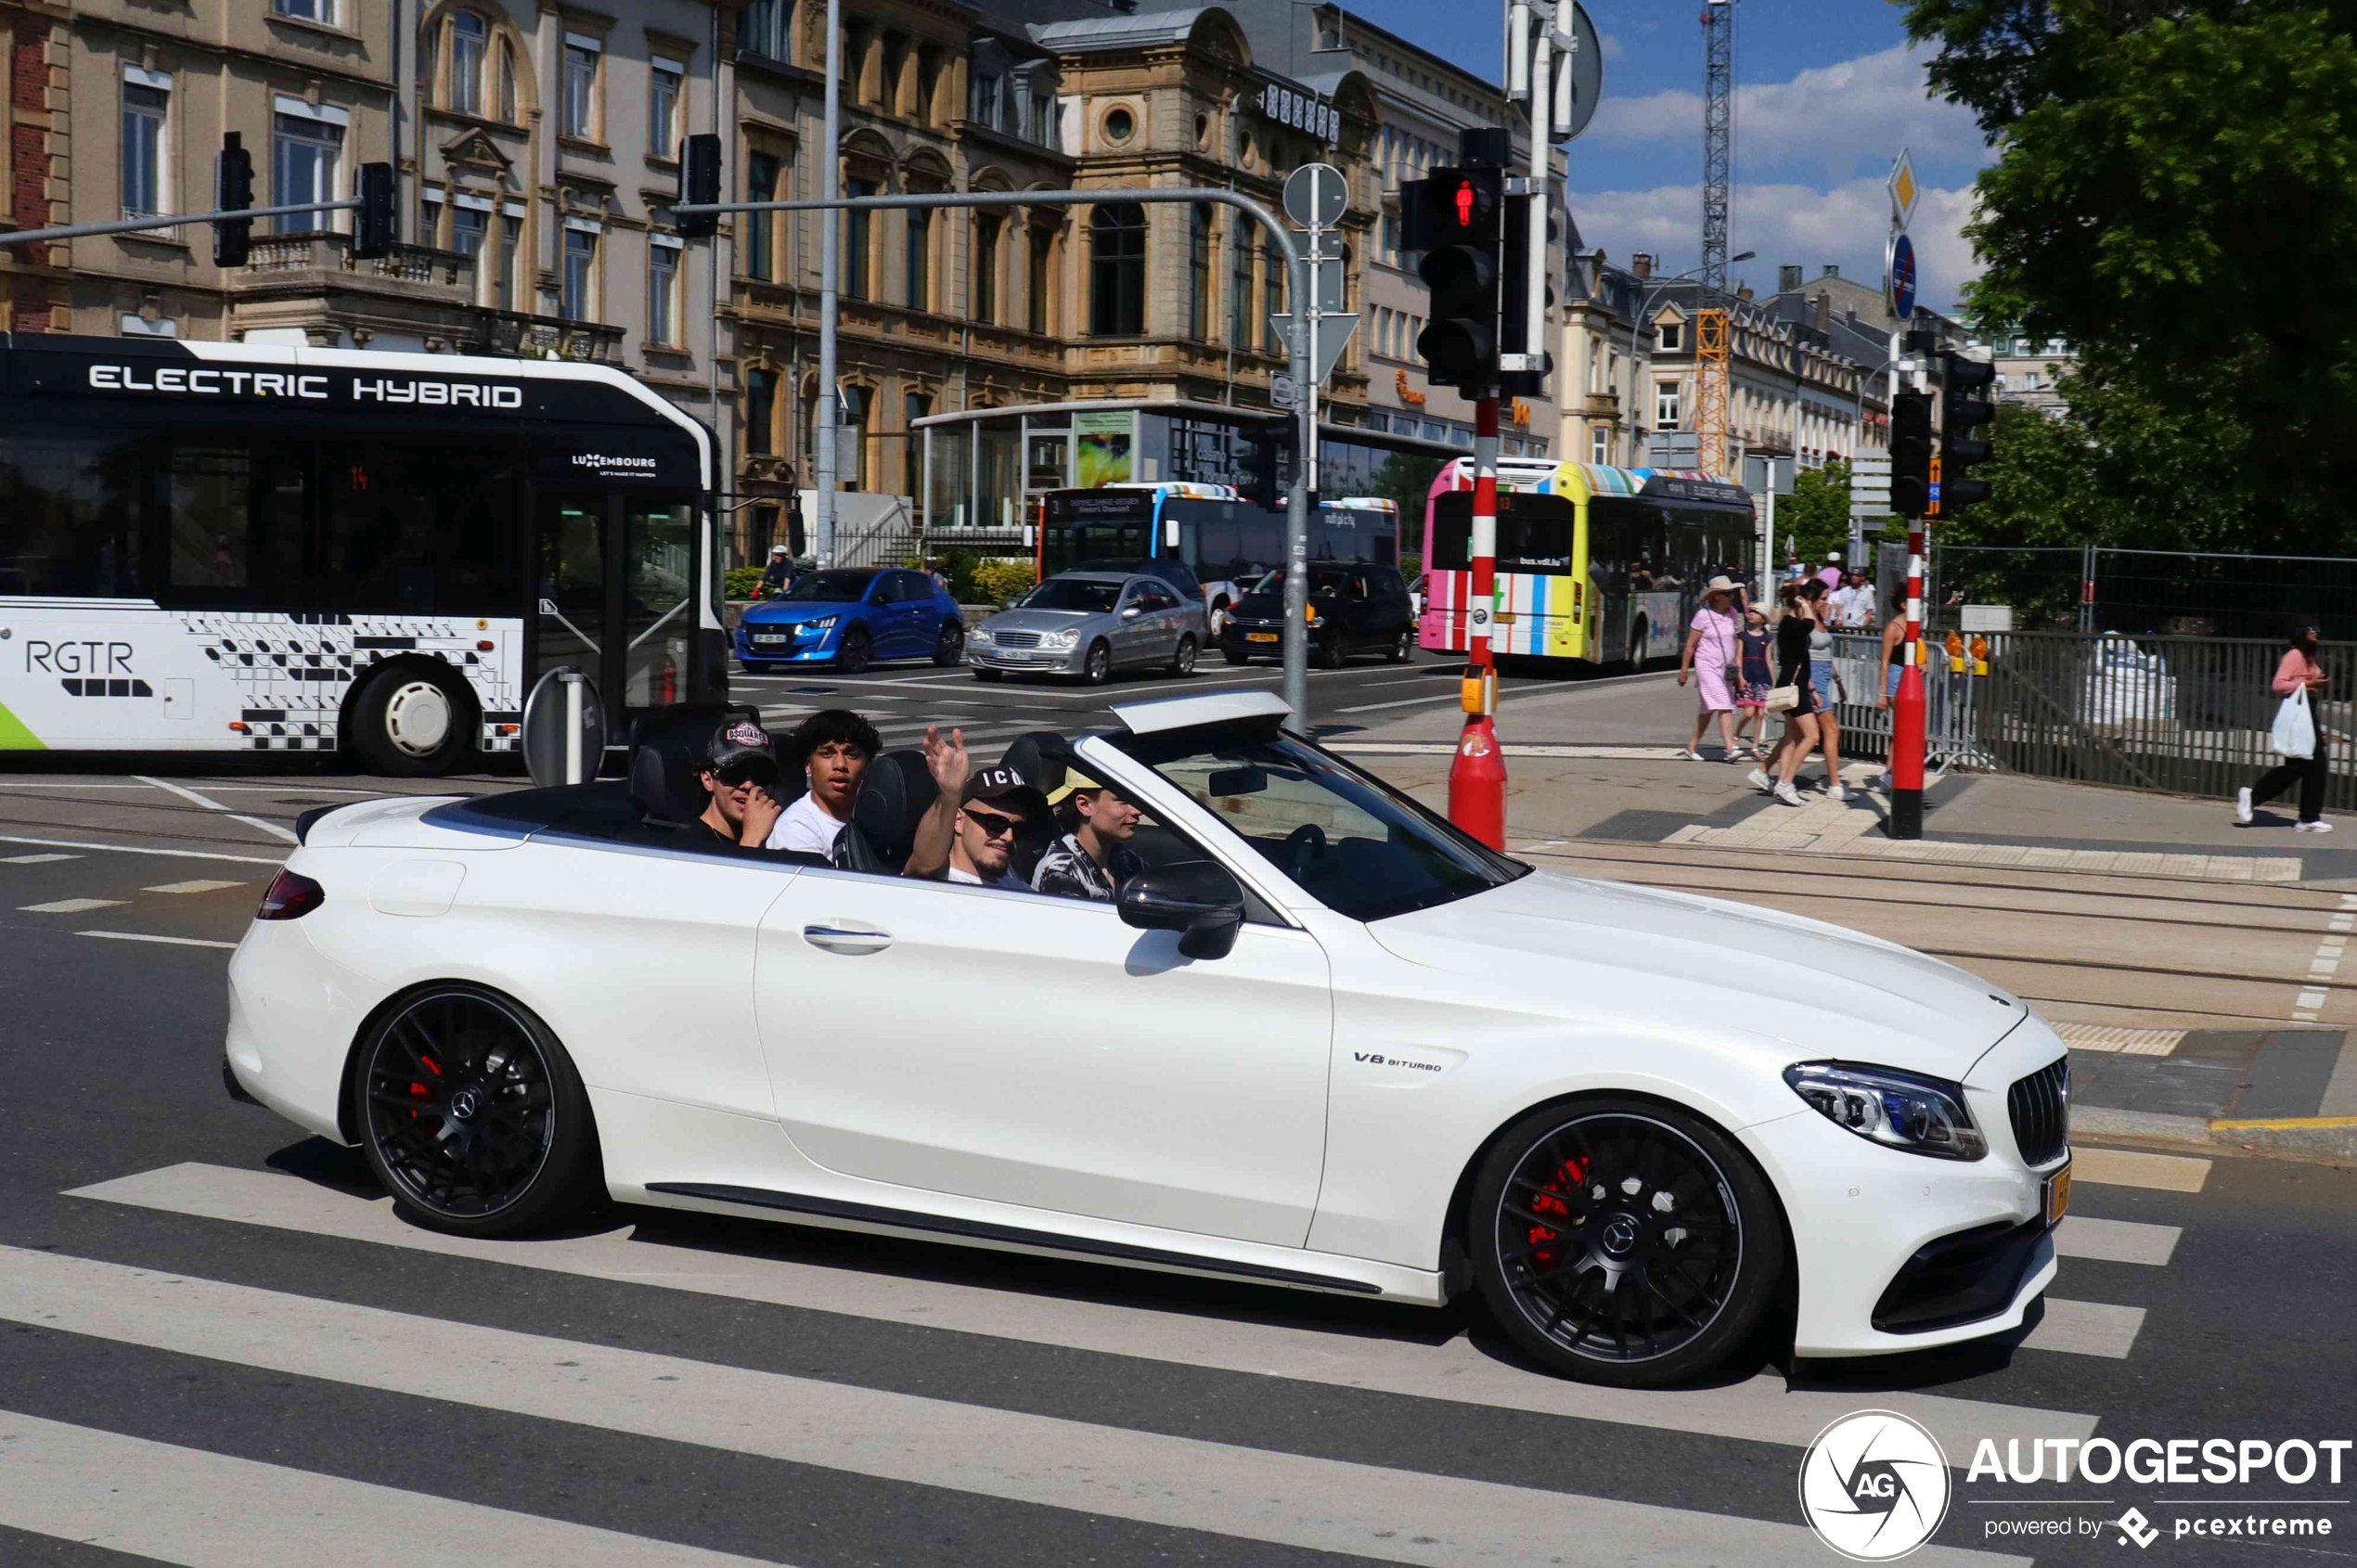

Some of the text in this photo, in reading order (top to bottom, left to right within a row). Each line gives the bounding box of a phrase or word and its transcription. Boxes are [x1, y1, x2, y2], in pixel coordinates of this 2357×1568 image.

[88, 364, 522, 409] ELECTRIC HYBRID
[572, 454, 656, 468] LUXEMBOURG
[26, 640, 134, 675] RGTR
[1354, 1051, 1442, 1073] V8 BITURBO
